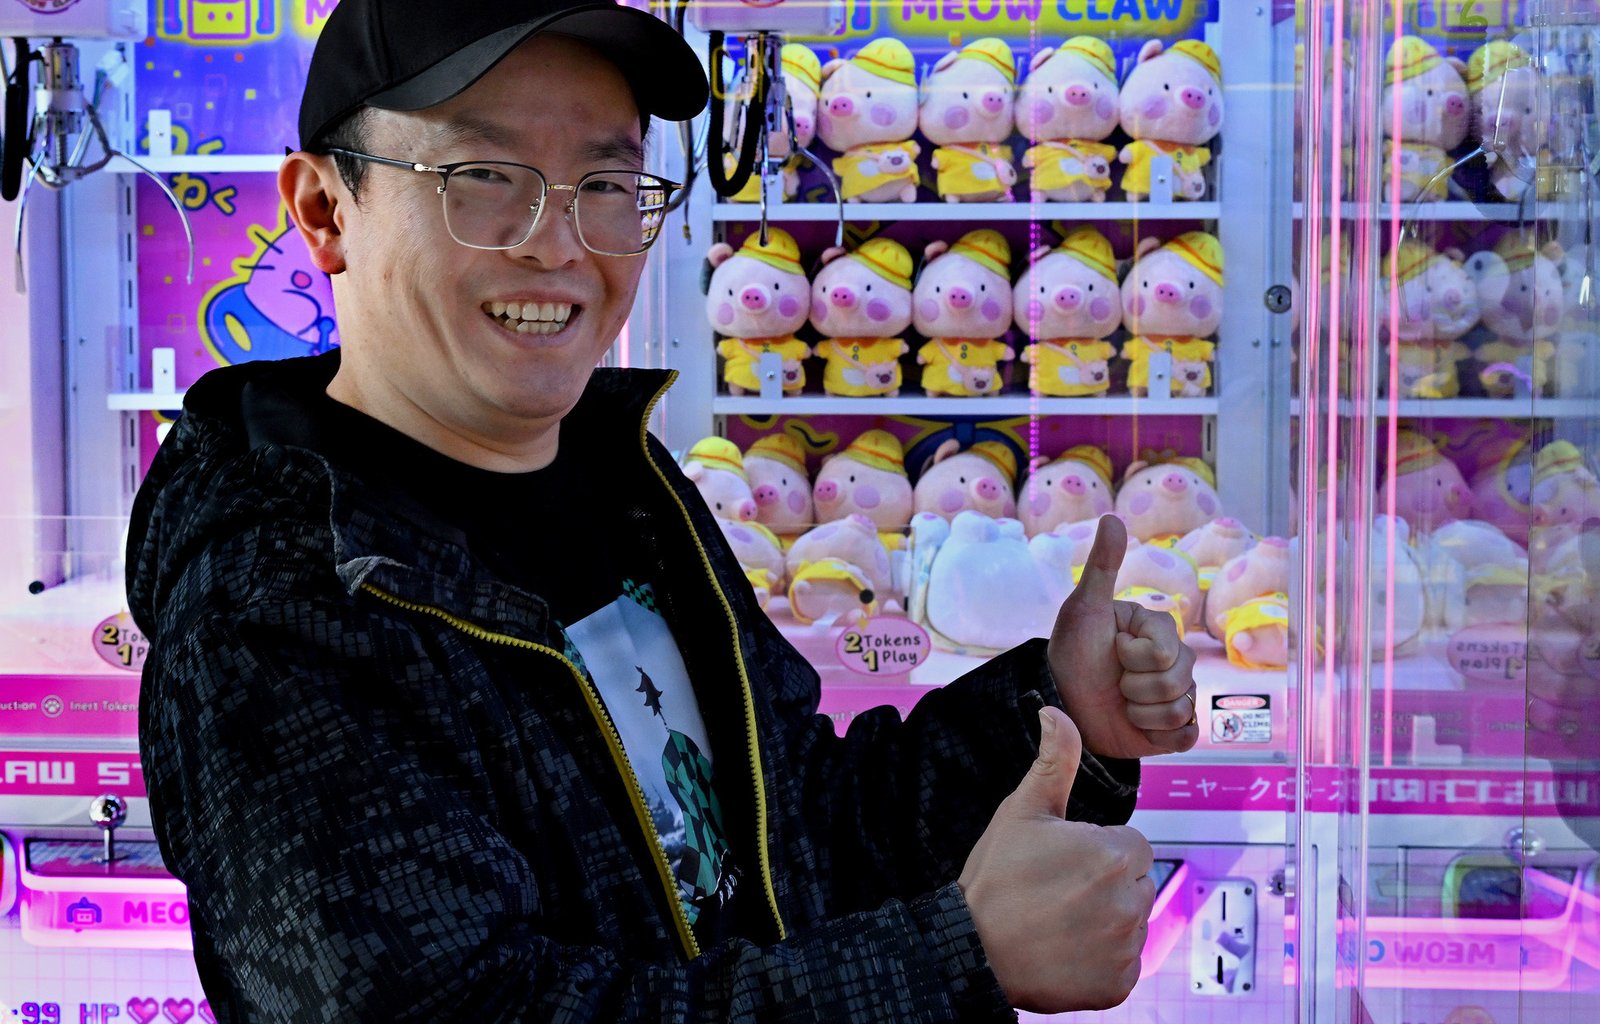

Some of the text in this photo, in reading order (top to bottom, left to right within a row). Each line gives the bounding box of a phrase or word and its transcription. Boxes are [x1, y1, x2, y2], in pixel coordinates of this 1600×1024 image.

[902, 0, 1183, 21] MEOW CLAW
[102, 624, 119, 646] 2
[844, 632, 921, 654] 2 Tokens
[117, 643, 132, 666] 1
[862, 649, 918, 672] 1 Play
[0, 760, 142, 785] AW S
[79, 1003, 120, 1024] HP
